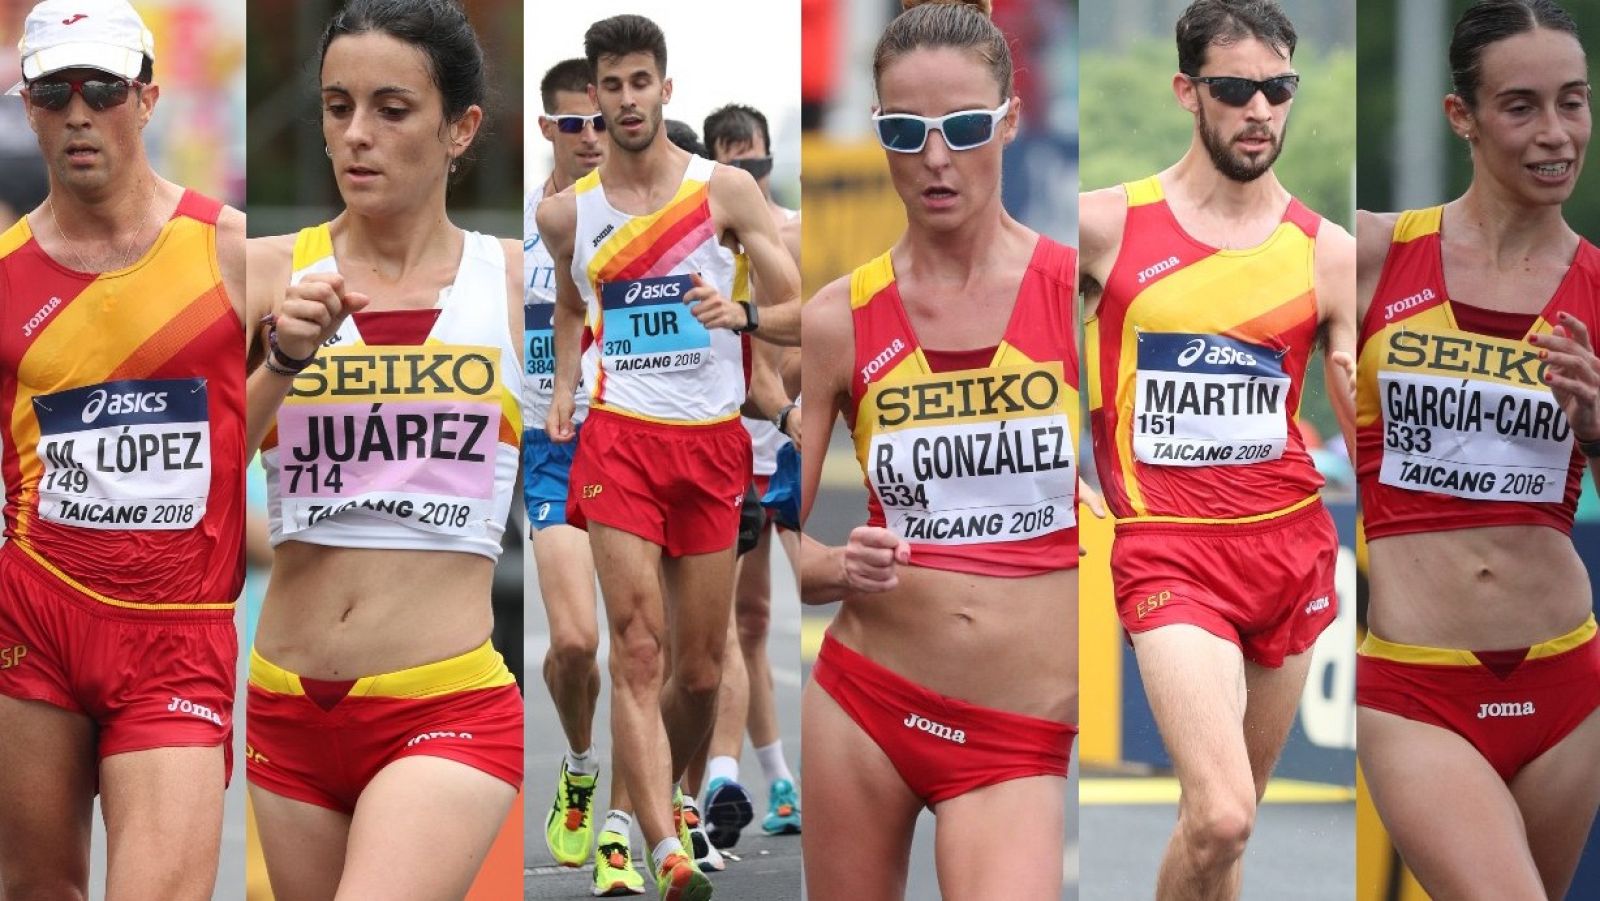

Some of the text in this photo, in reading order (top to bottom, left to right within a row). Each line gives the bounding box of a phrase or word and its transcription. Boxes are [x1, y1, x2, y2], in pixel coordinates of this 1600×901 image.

[1137, 256, 1181, 284] Joma
[641, 282, 681, 300] asics
[1384, 288, 1436, 320] Joma
[22, 295, 62, 337] Joma
[629, 311, 679, 338] TUR
[529, 336, 555, 359] GI
[604, 340, 632, 356] 370
[860, 337, 905, 385] Joma
[1205, 346, 1257, 366] asics
[286, 353, 495, 397] SEIKO
[614, 353, 701, 372] TAICANG 2018
[107, 391, 169, 415] asics
[875, 370, 1059, 427] SEIKO
[1144, 376, 1280, 416] MARTÍN
[292, 403, 489, 463] JUÁREZ
[1137, 414, 1175, 435] 151
[1386, 422, 1432, 453] 533
[46, 426, 203, 473] M. LÓPEZ
[876, 421, 1070, 484] R. GONZÁLEZ
[1152, 442, 1273, 462] TAICANG 2018
[46, 471, 88, 493] 149
[284, 463, 343, 493] 714
[582, 484, 603, 499] ESP
[1399, 461, 1546, 495] TAICANG 2018
[877, 483, 930, 509] 534
[59, 501, 194, 524] TAICANG 2018
[418, 502, 470, 528] 2018
[904, 505, 1054, 539] TAICANG 2018
[1136, 590, 1172, 620] ESP
[167, 696, 224, 726] Joma
[1477, 700, 1536, 719] Joma
[903, 712, 967, 744] Joma
